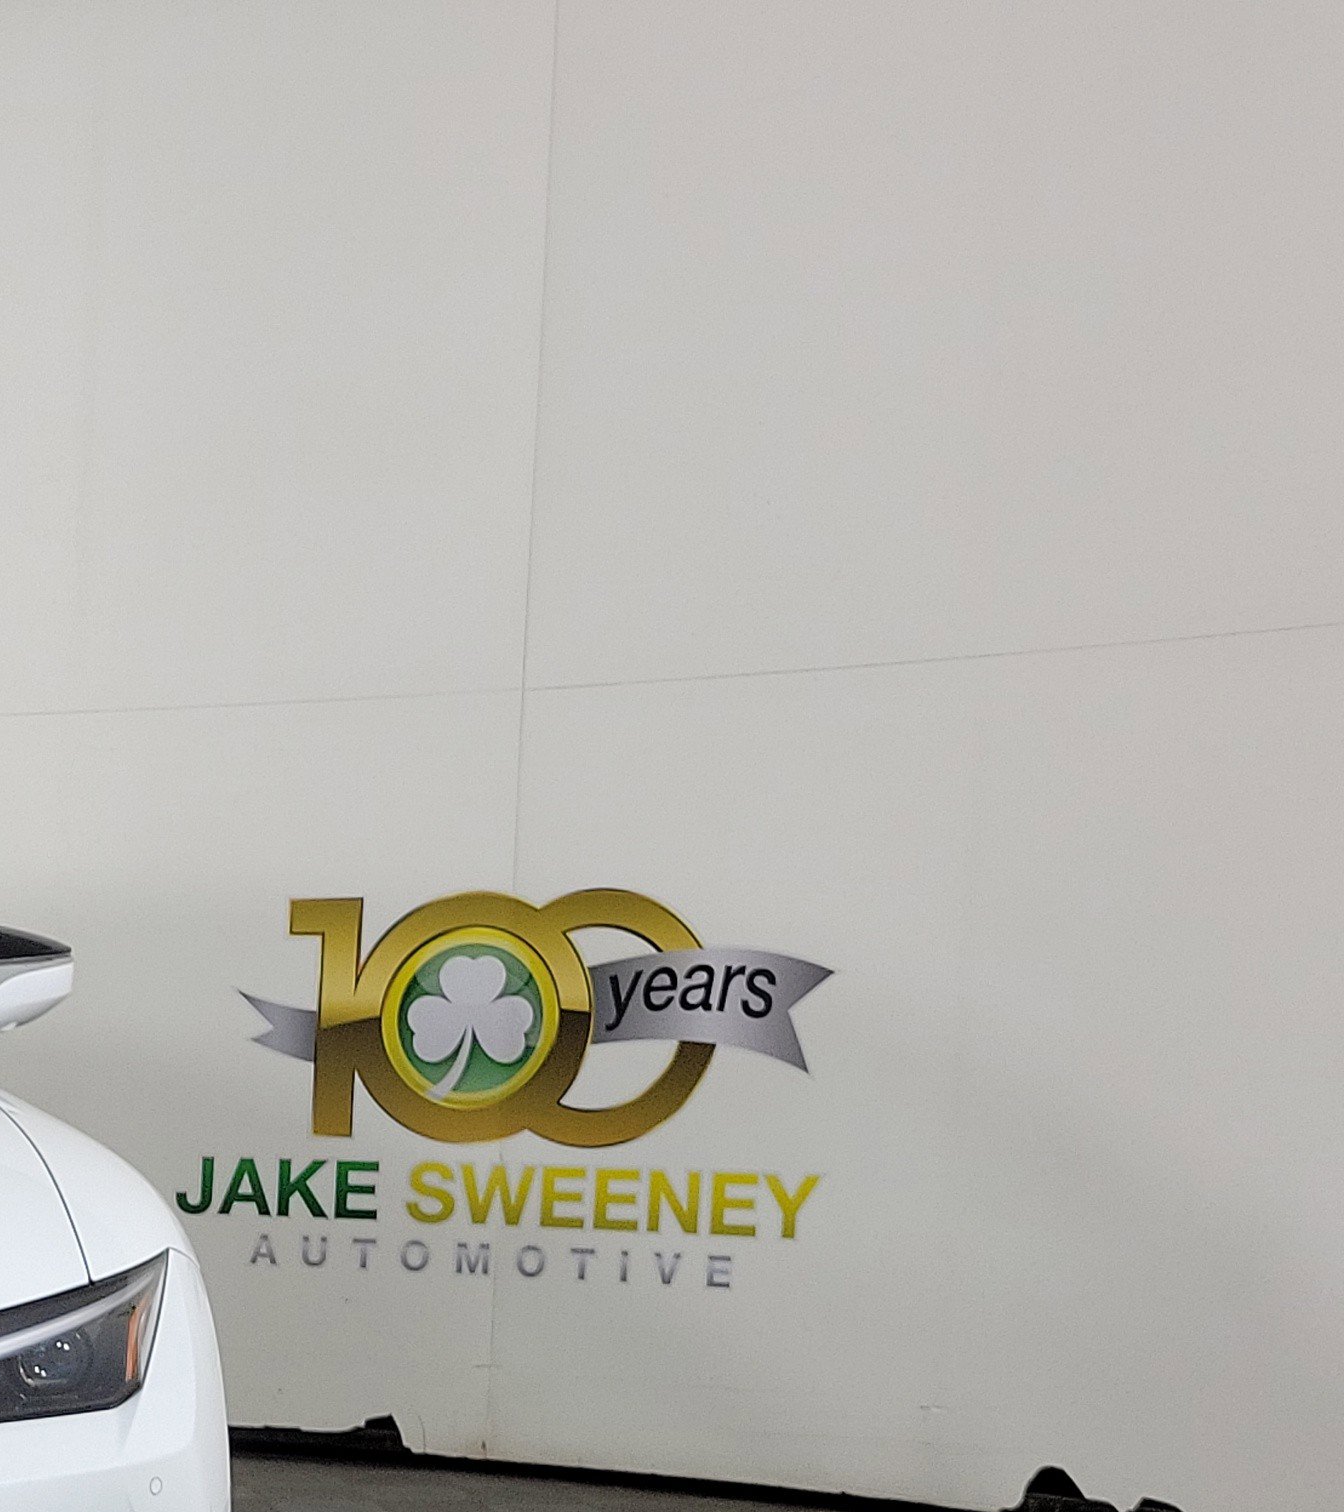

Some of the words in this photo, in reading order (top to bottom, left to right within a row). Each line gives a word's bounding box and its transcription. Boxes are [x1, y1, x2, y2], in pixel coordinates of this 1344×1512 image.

[288, 887, 717, 1148] 100
[605, 963, 778, 1032] years
[174, 1155, 380, 1221] JAKE
[405, 1160, 822, 1240] SWEENEY
[250, 1233, 732, 1289] AUTOMOTIVE
